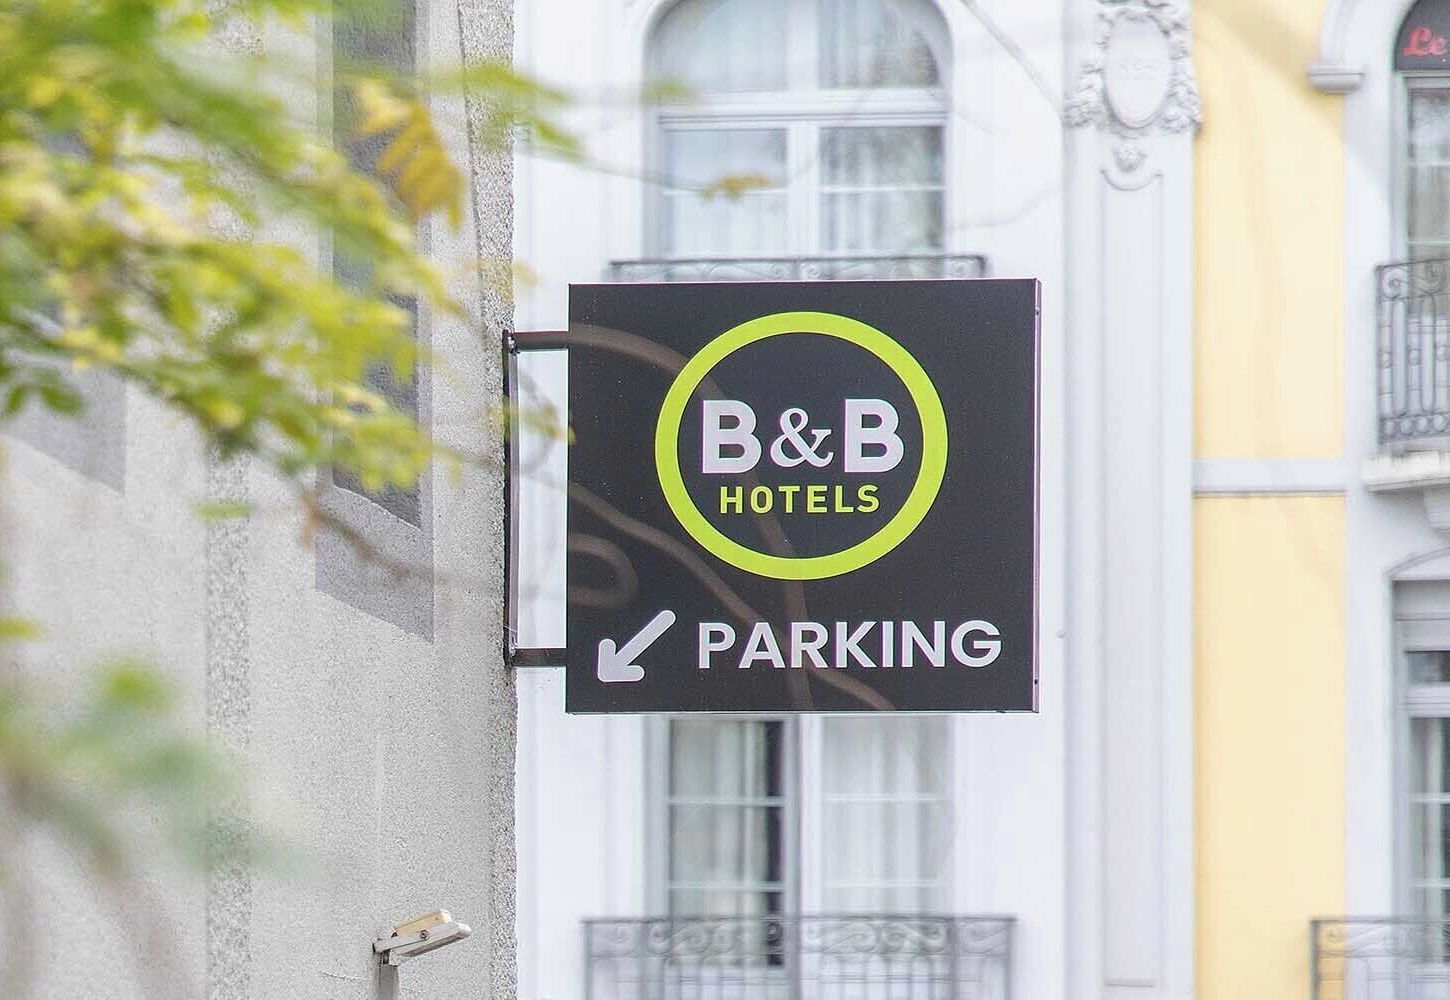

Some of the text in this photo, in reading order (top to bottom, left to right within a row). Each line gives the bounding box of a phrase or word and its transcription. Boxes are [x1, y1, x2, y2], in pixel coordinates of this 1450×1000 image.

[702, 398, 905, 474] B&B
[719, 484, 880, 514] HOTELS
[698, 620, 1002, 669] PARKING
